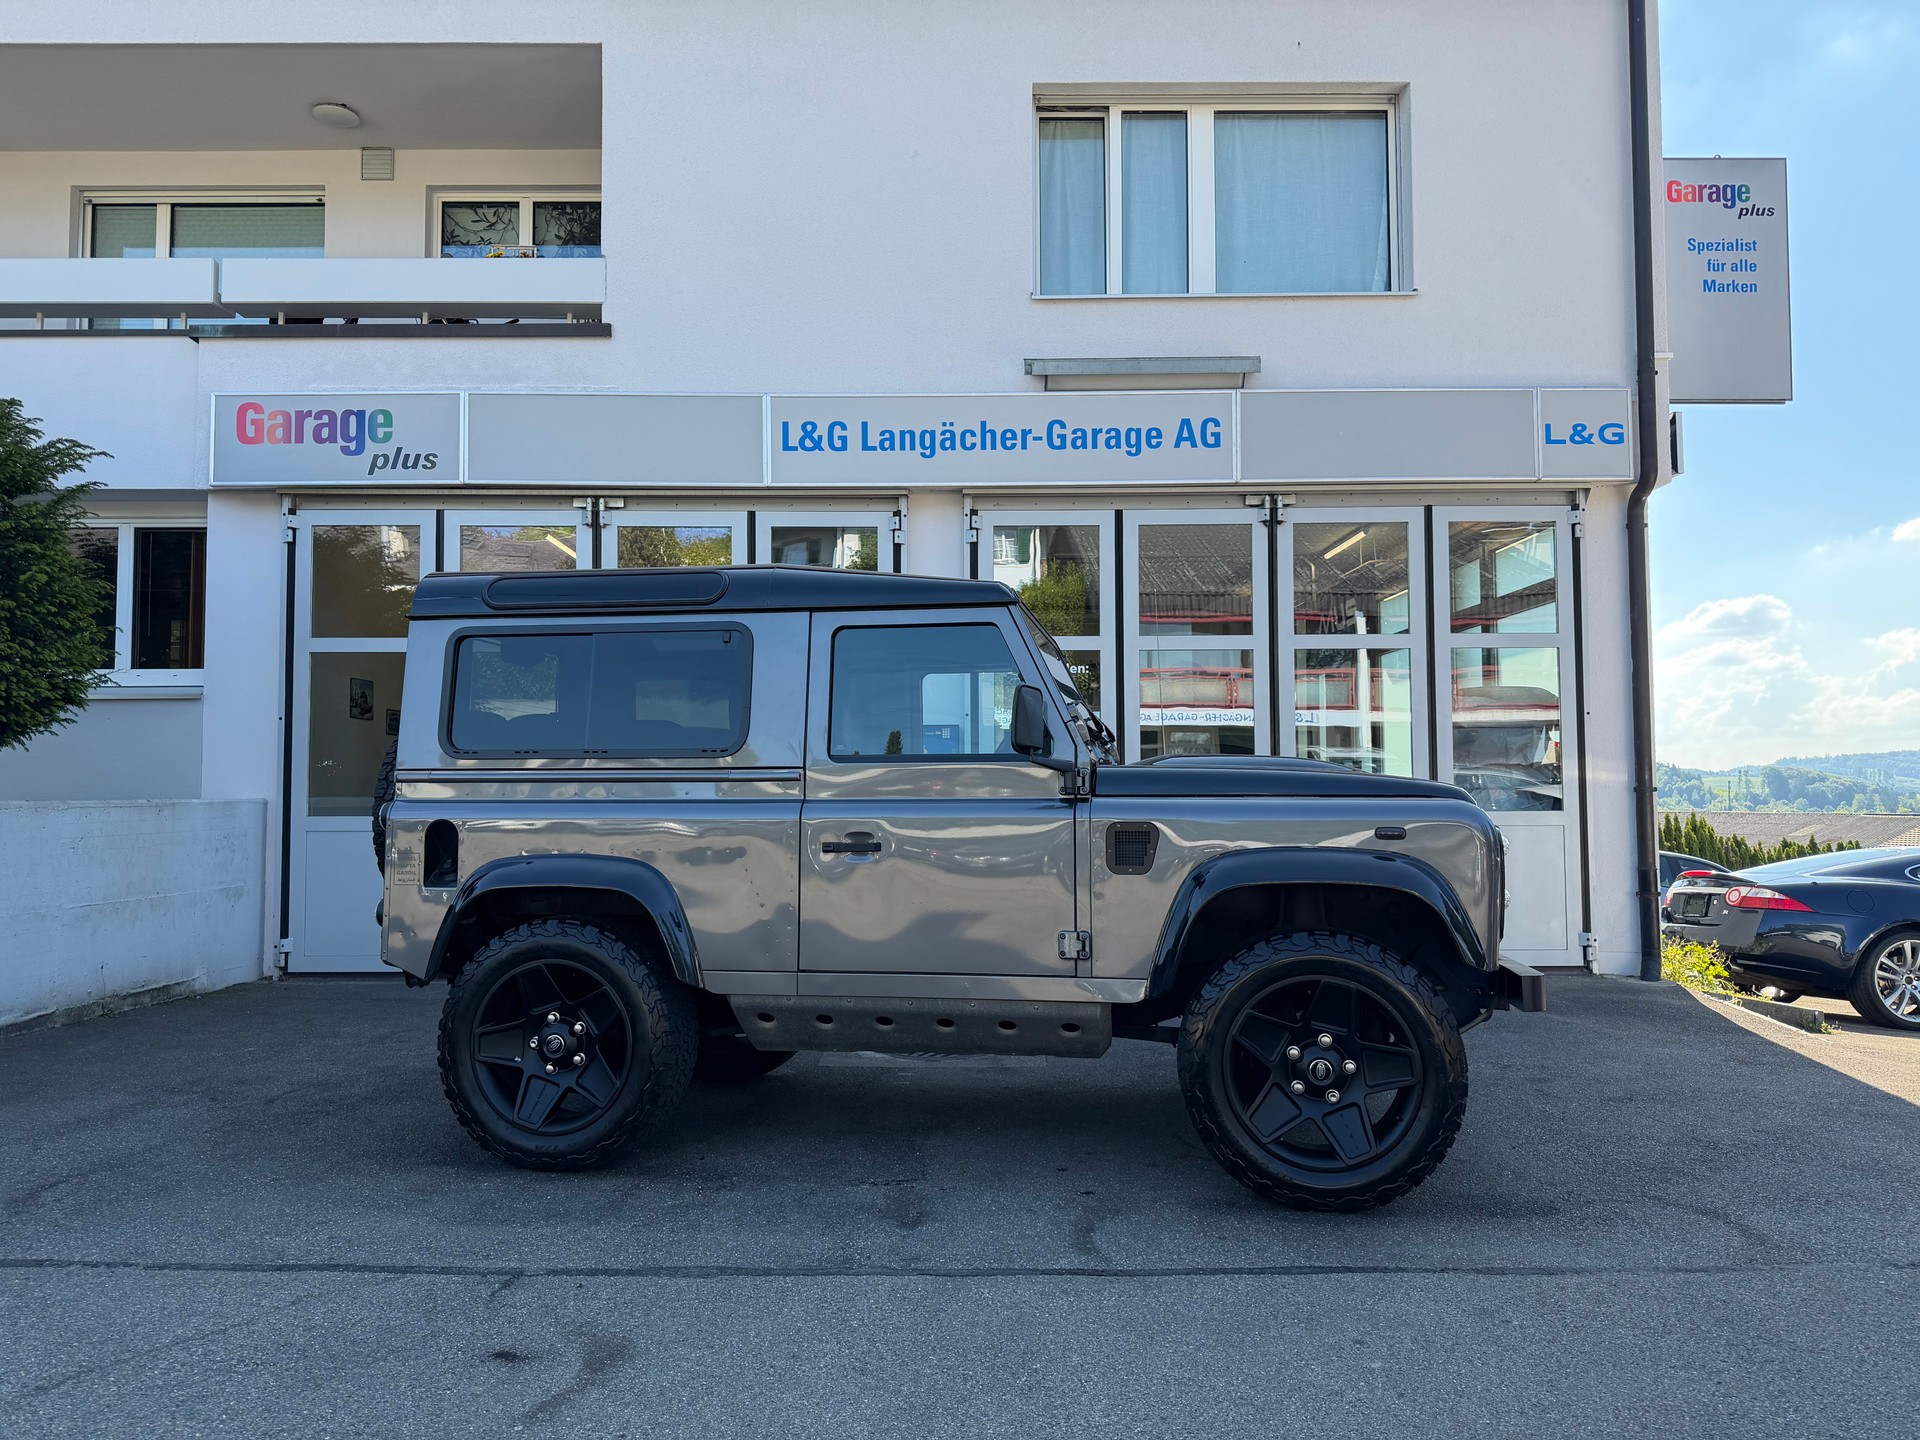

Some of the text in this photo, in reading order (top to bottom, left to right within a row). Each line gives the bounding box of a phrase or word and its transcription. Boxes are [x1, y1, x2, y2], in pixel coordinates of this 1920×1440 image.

[1667, 180, 1751, 208] Garage
[1737, 204, 1775, 220] plus
[1687, 237, 1758, 256] Spezialist
[1707, 259, 1758, 273] für alle
[1702, 279, 1758, 293] Marken
[236, 401, 394, 457] Garage
[781, 417, 1222, 459] L&G Langächer-Garage AG
[1544, 422, 1625, 445] L&G
[367, 446, 439, 476] plus
